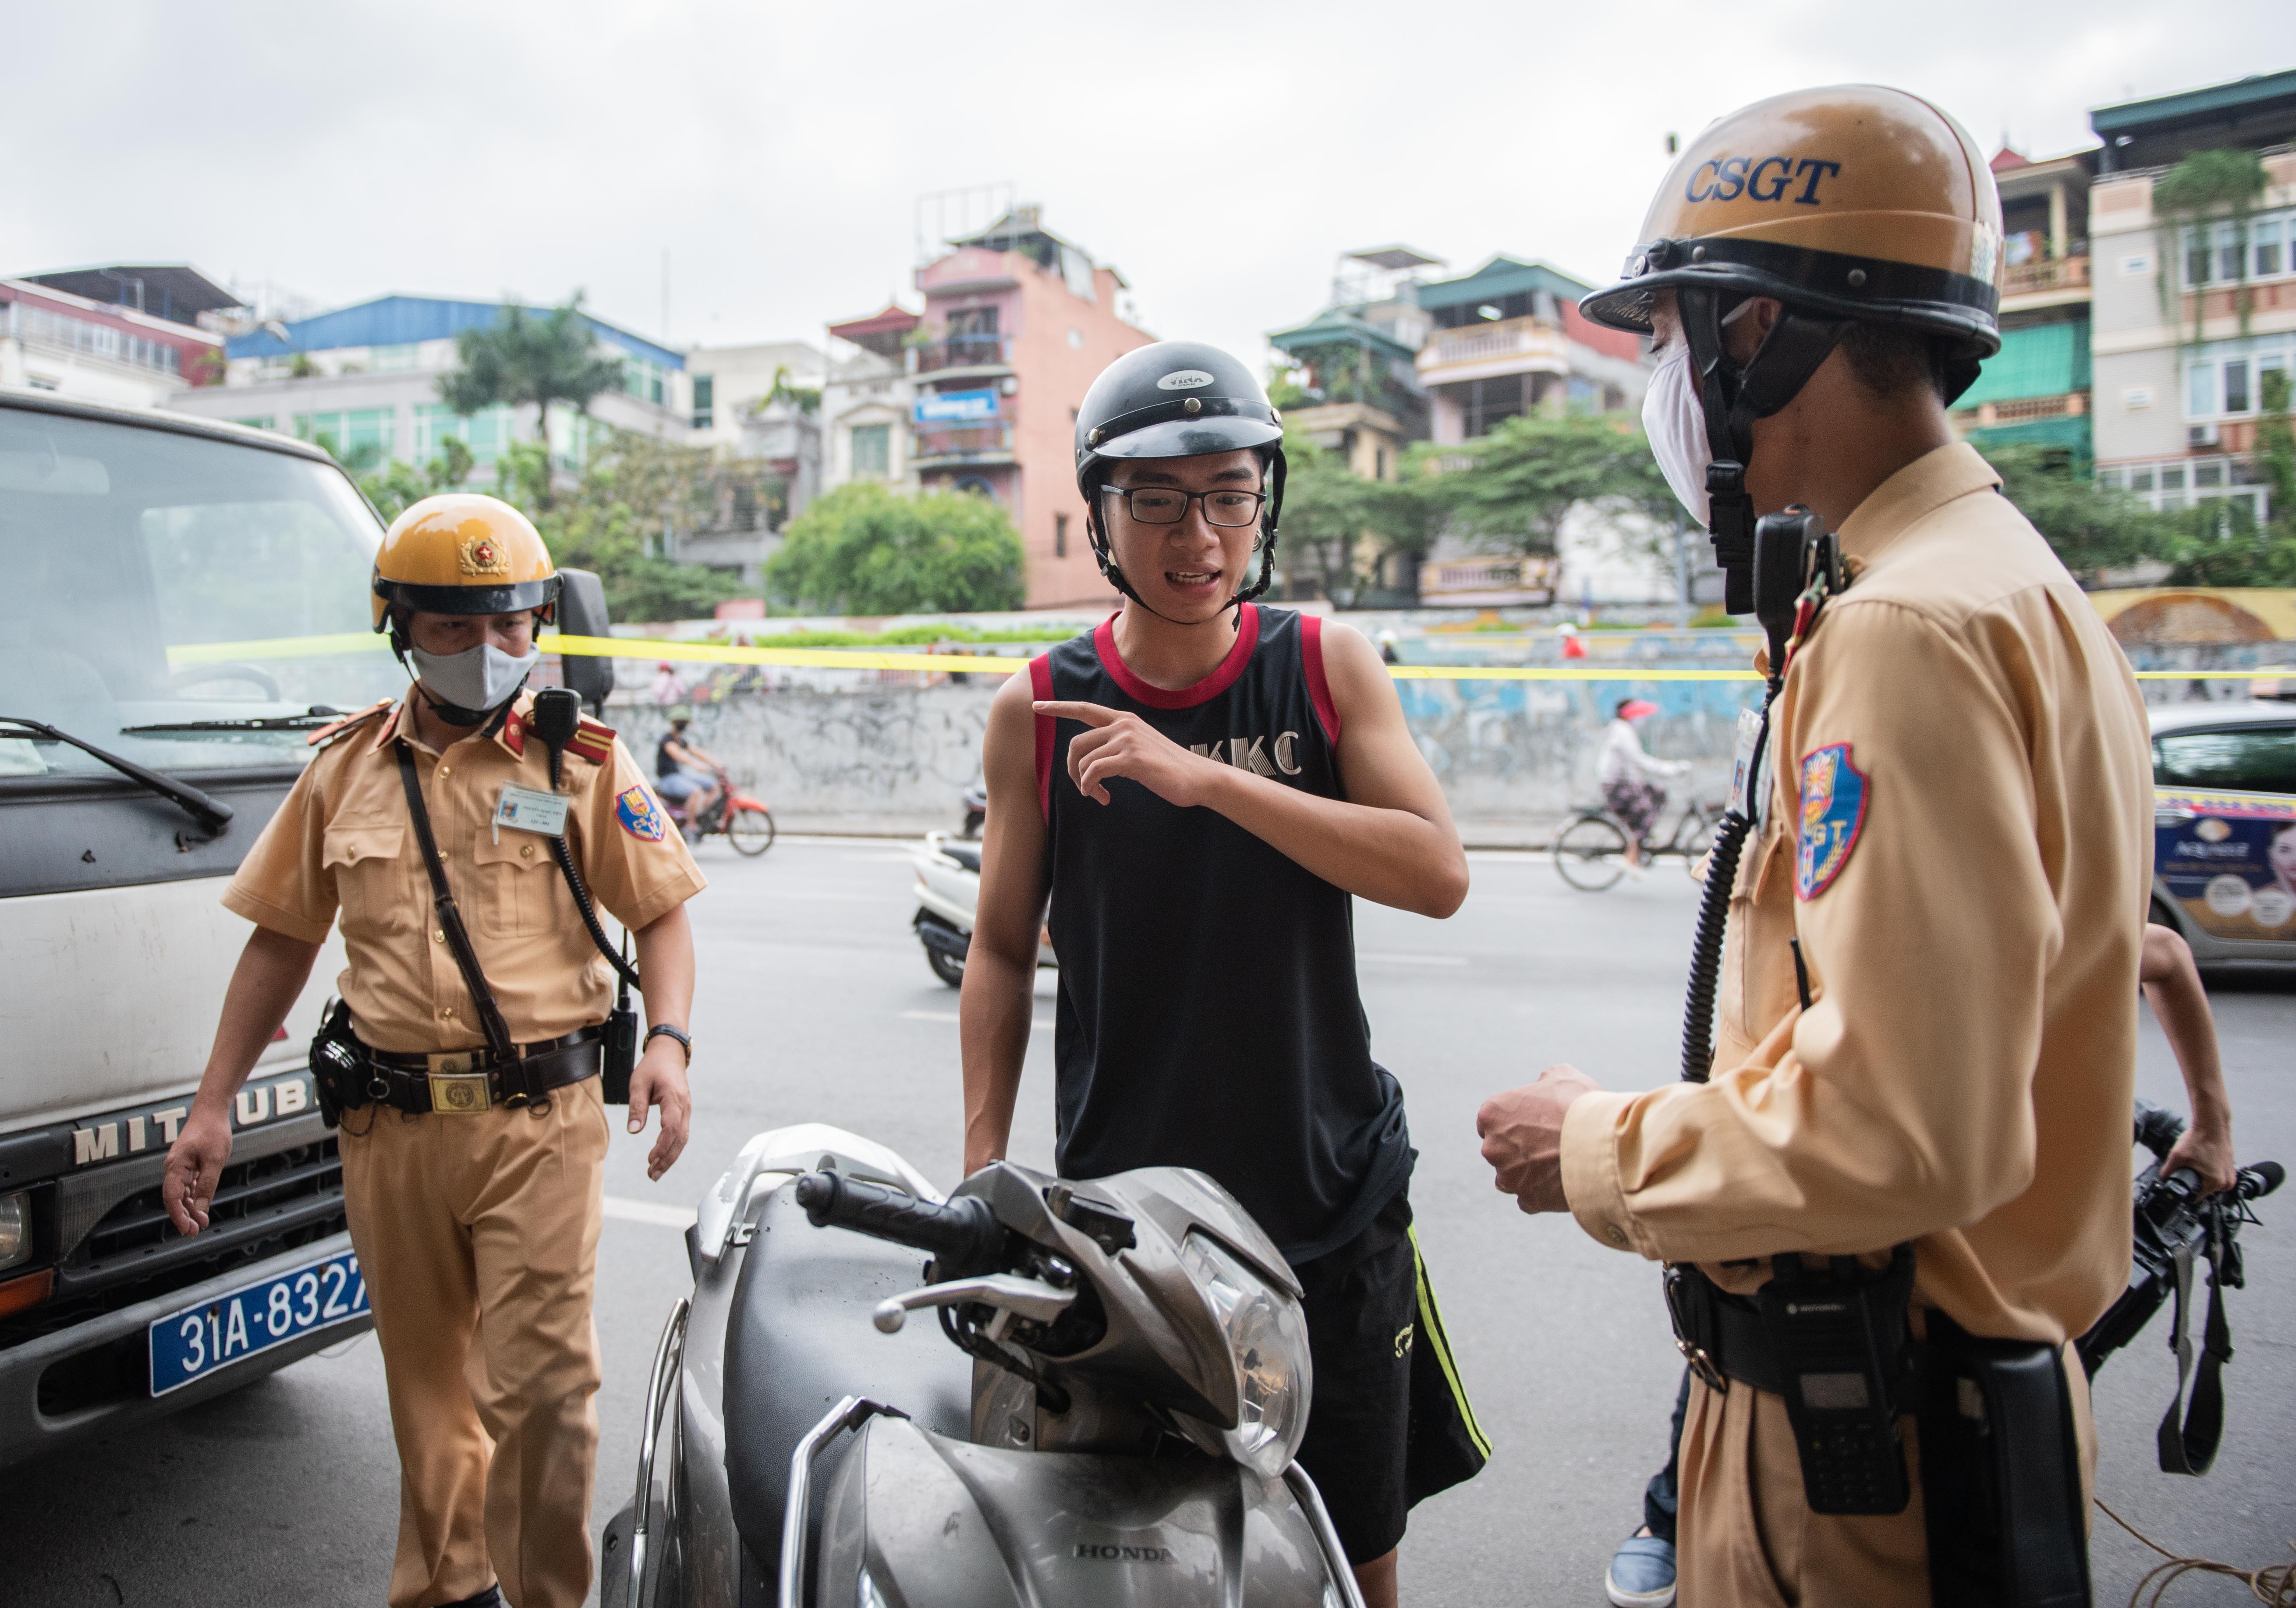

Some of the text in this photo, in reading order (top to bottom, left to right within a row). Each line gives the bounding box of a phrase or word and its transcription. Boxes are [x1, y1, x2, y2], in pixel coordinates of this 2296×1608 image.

[1685, 156, 1842, 206] CSGT
[1167, 375, 1204, 385] VINA
[72, 1079, 320, 1165] MITUB
[180, 1257, 366, 1373] 31A-8327
[1077, 1545, 1180, 1564] HONDA
